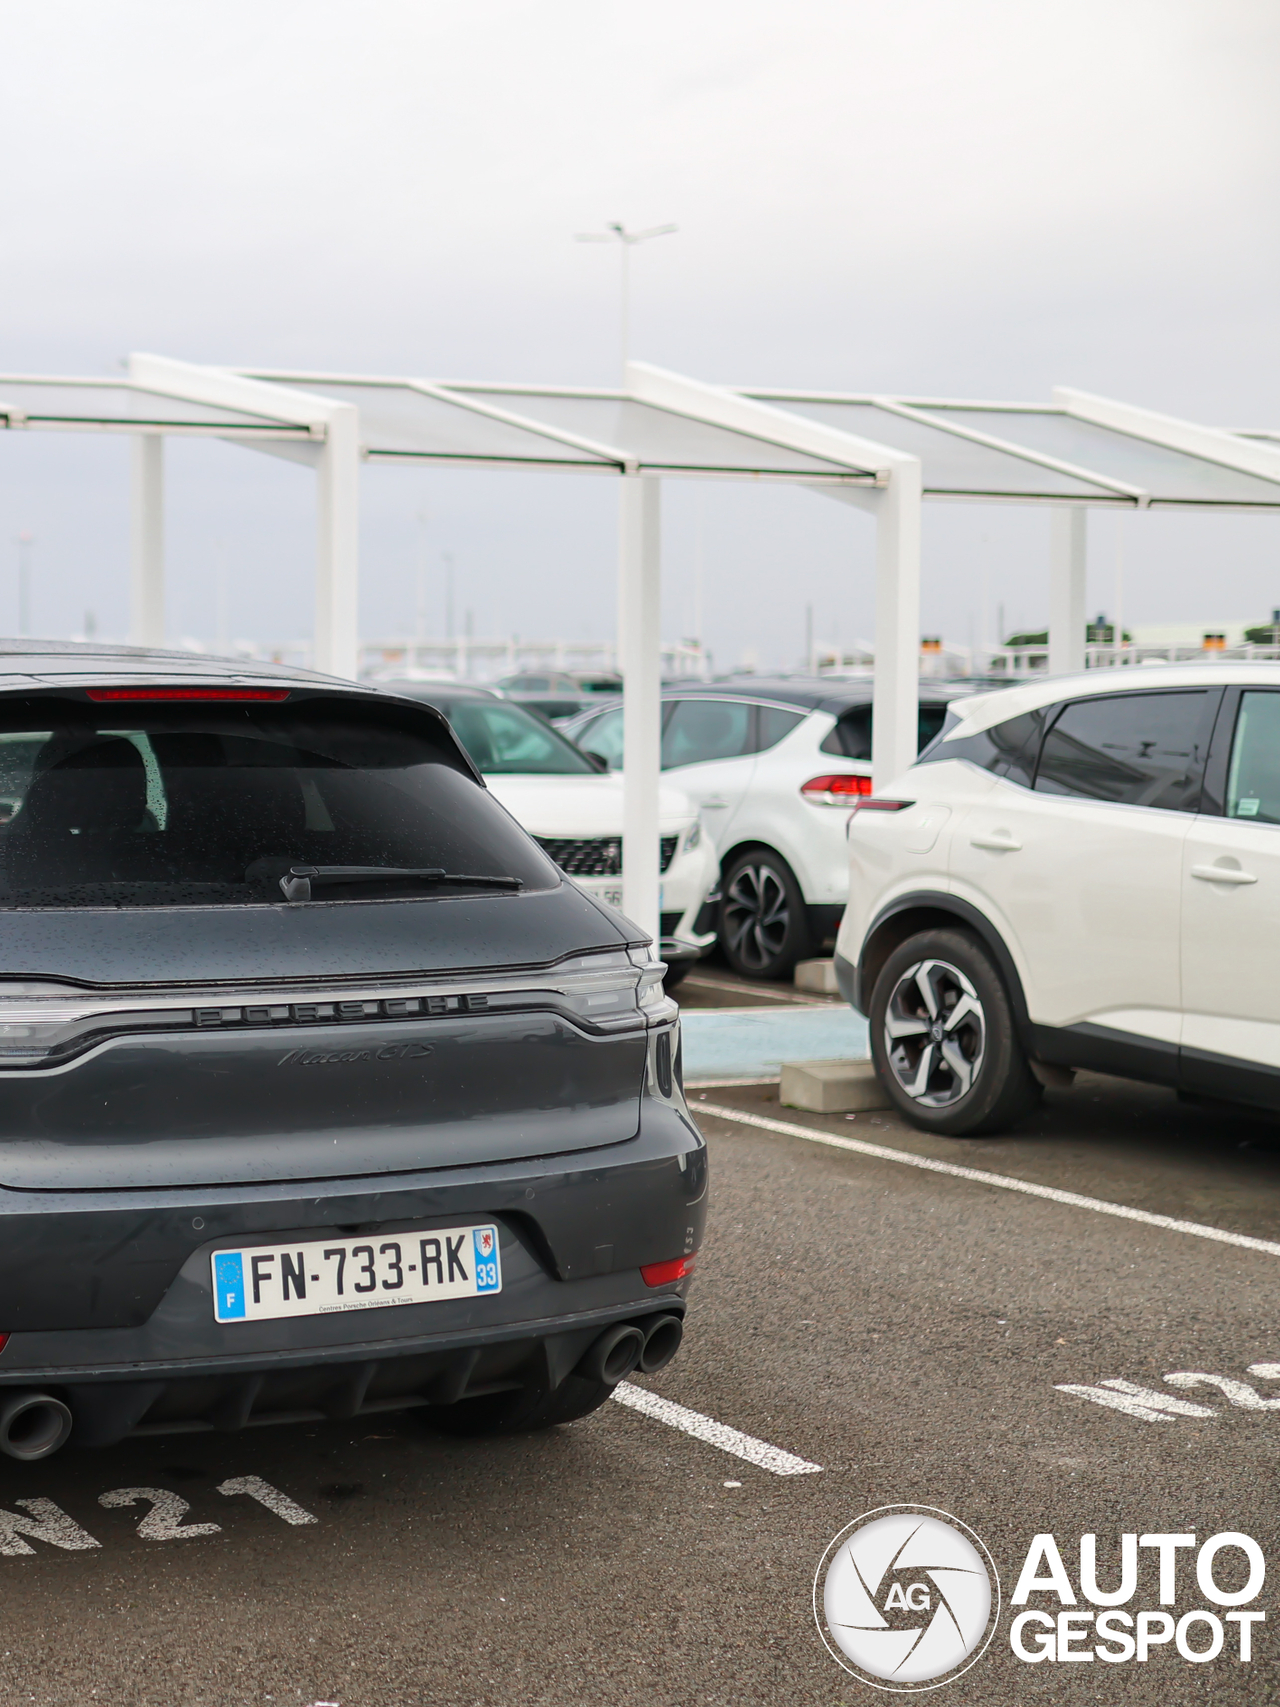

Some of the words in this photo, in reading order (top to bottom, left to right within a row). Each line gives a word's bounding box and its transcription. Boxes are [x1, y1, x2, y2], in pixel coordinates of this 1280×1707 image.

[193, 994, 489, 1026] PORSCHE
[277, 1048, 370, 1067] Macan
[376, 1040, 437, 1061] GTS
[251, 1235, 469, 1304] FN-733-RK
[477, 1263, 497, 1287] 33
[226, 1293, 236, 1308] F
[319, 1304, 342, 1313] Centres
[343, 1302, 367, 1311] Porsche
[368, 1299, 390, 1308] Orléans
[1052, 1363, 1280, 1422] N2
